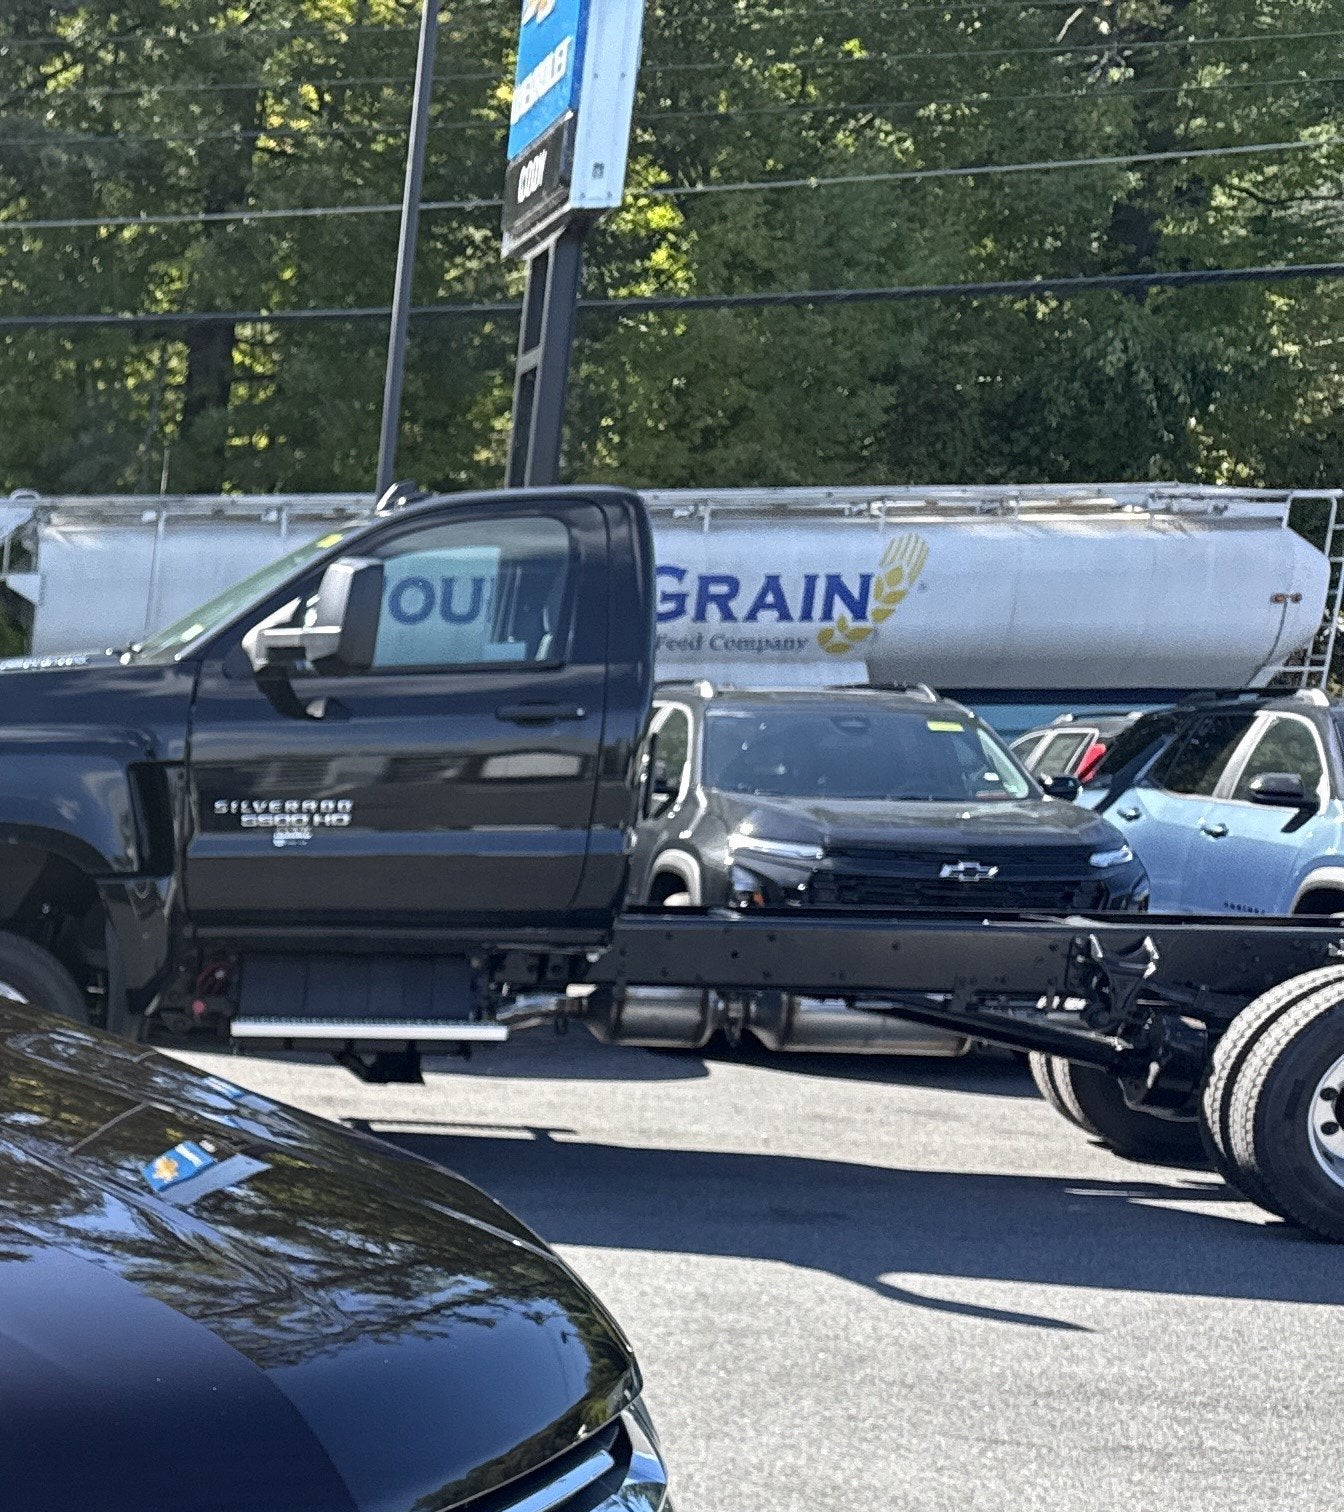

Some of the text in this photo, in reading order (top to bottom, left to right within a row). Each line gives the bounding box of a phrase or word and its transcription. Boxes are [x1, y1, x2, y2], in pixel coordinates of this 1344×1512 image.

[388, 565, 874, 625] OU GRAIN
[710, 632, 808, 654] Company
[214, 800, 353, 814] SILVERADO
